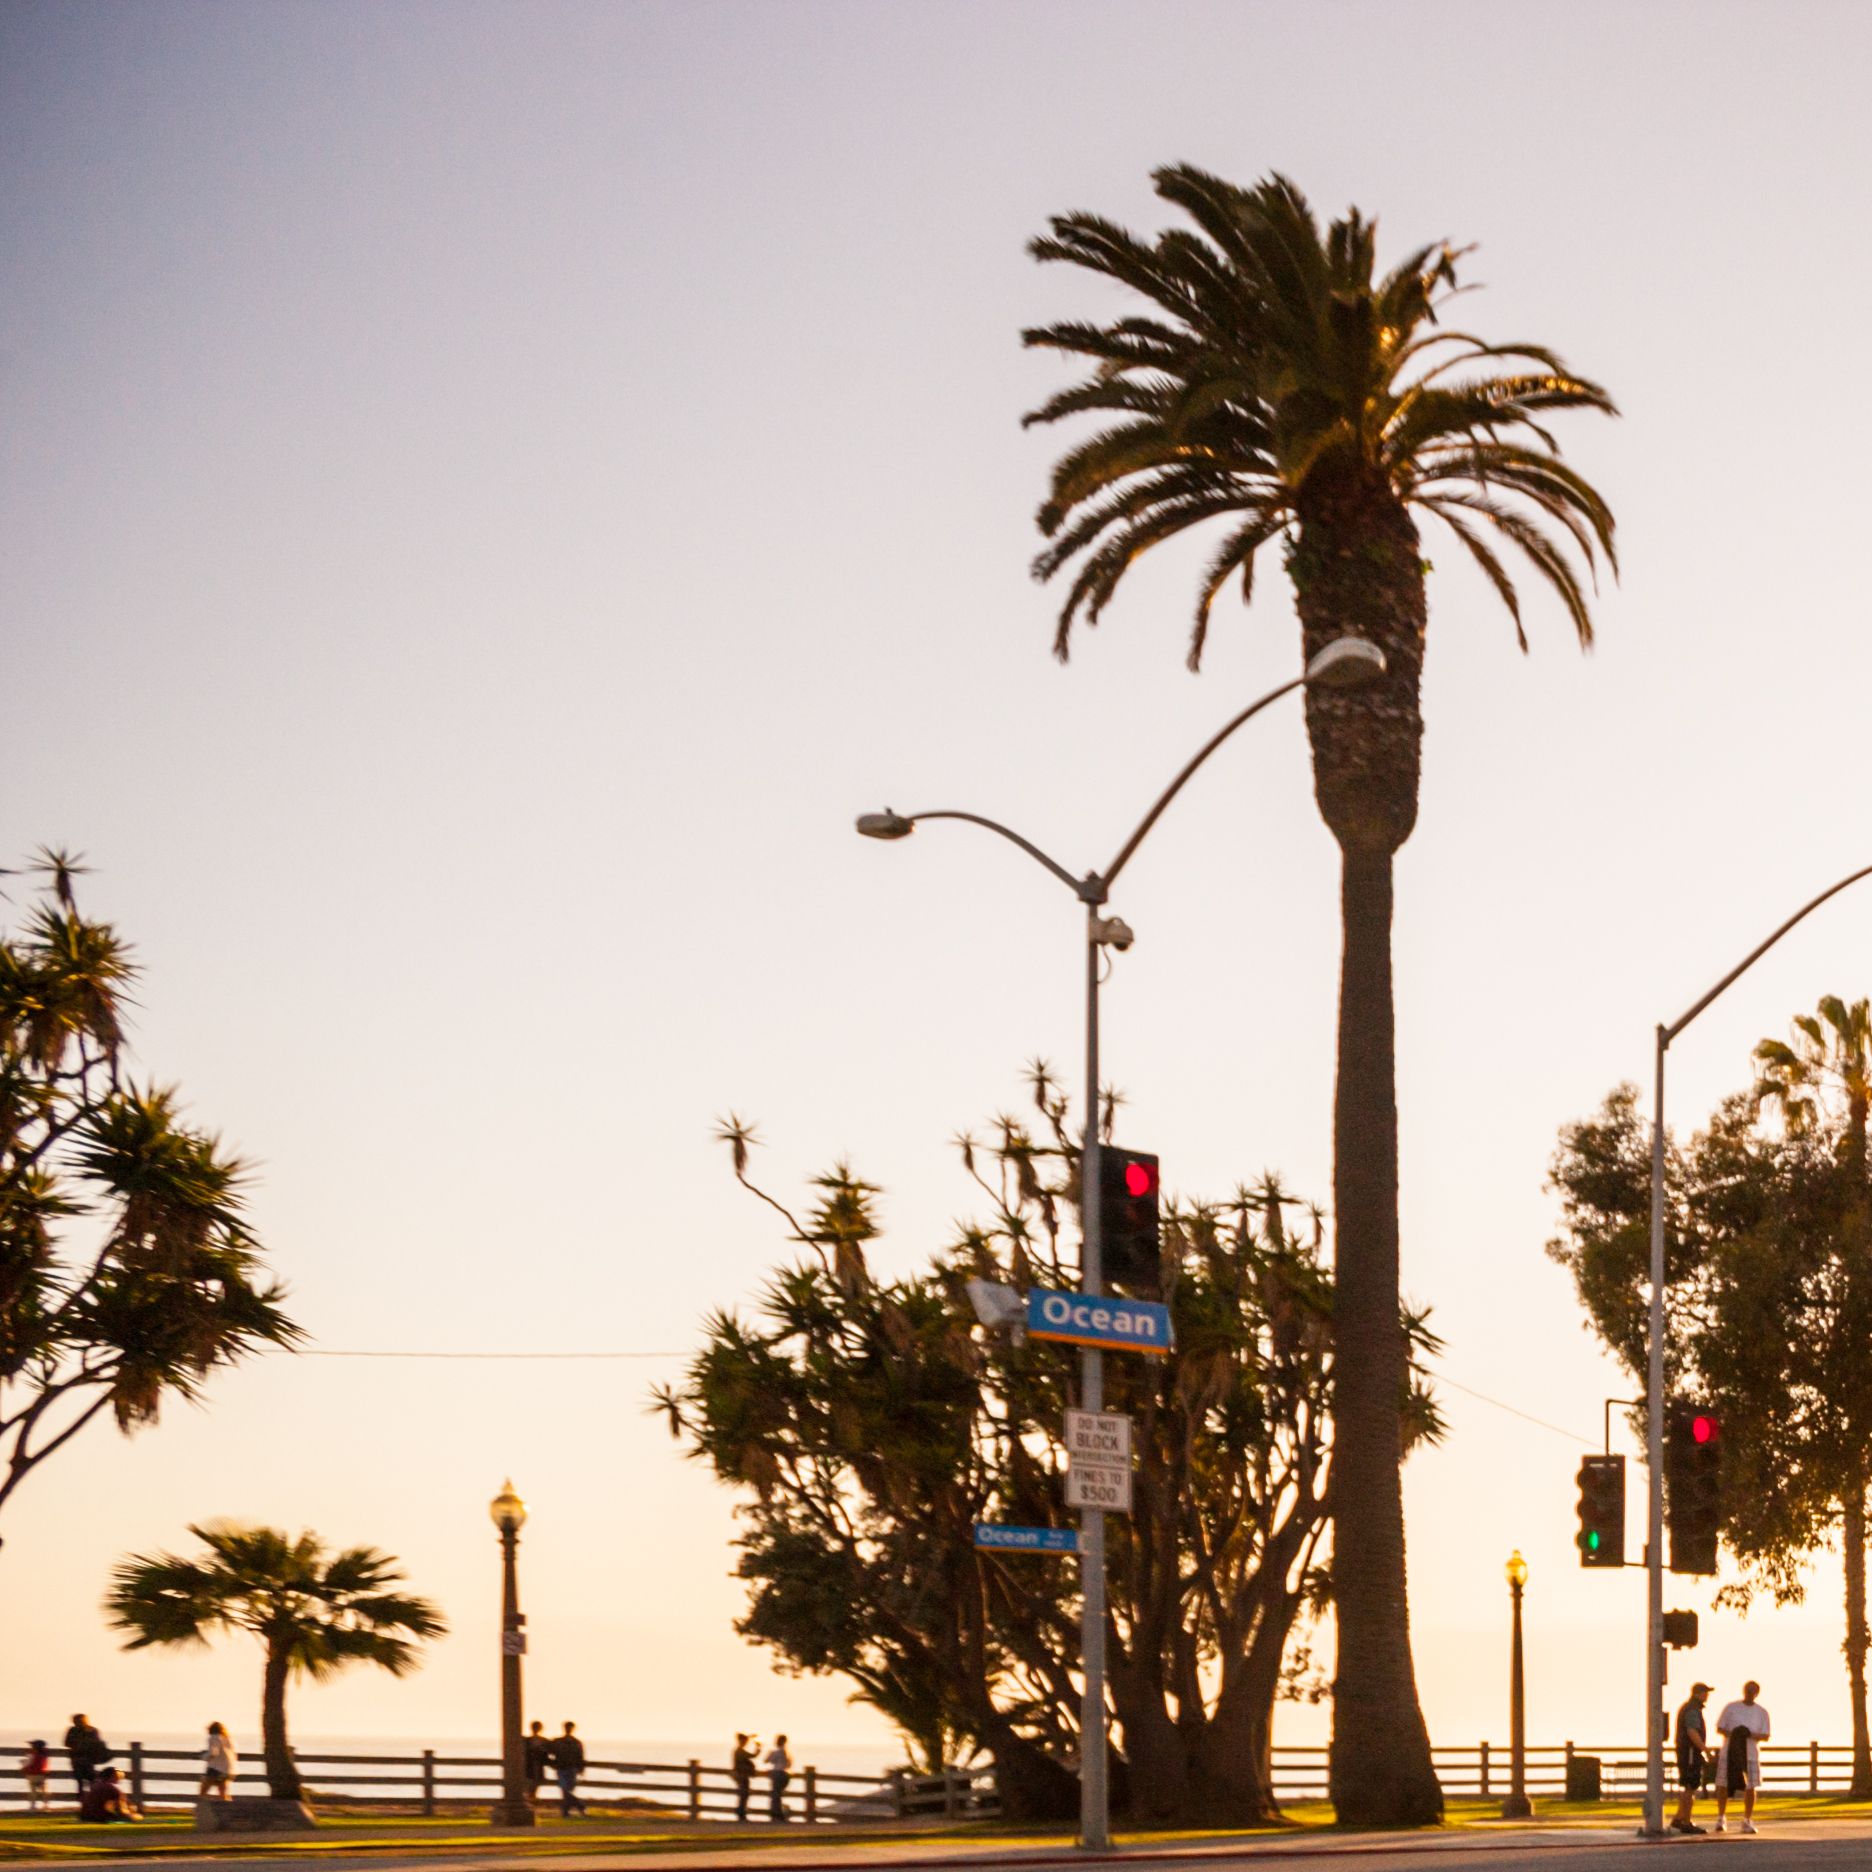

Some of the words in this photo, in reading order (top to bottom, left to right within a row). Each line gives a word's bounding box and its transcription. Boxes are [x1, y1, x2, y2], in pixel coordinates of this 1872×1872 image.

[1042, 1295, 1157, 1337] Ocean
[1076, 1432, 1118, 1450] BLOCK
[1081, 1485, 1117, 1502] $500
